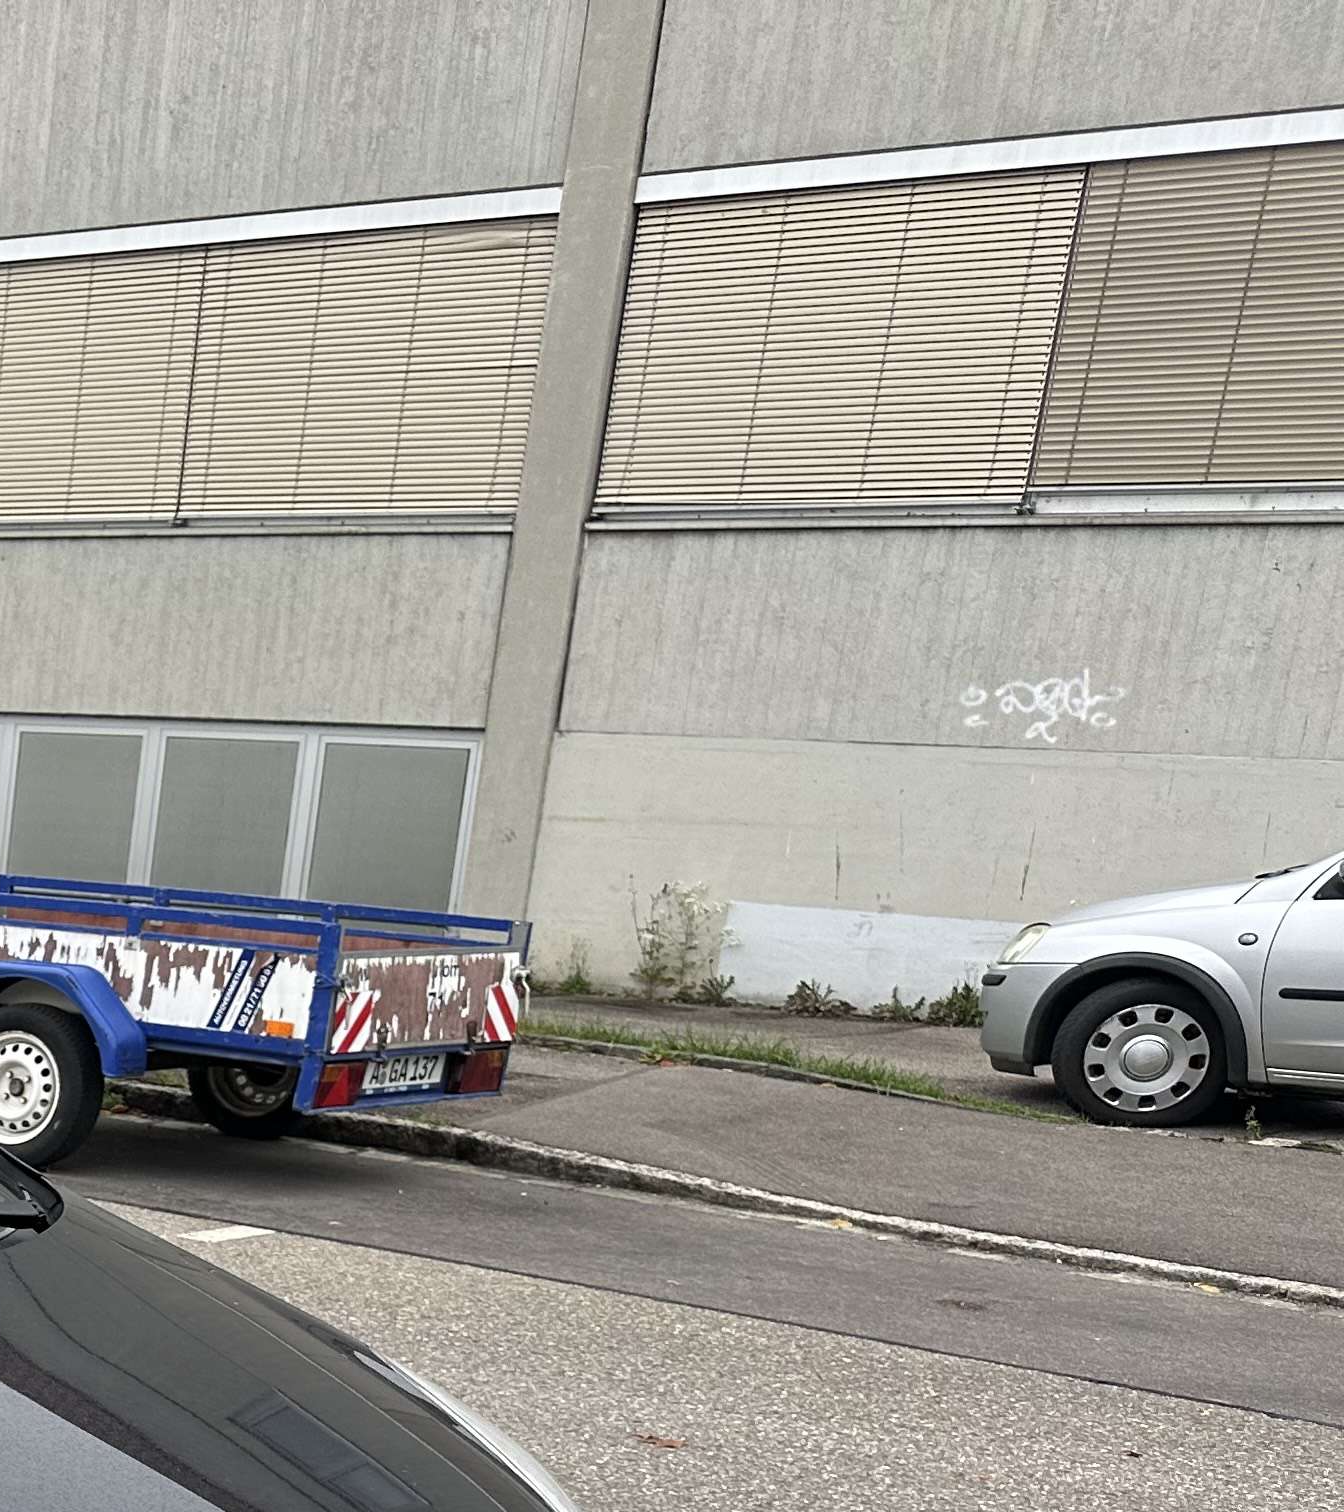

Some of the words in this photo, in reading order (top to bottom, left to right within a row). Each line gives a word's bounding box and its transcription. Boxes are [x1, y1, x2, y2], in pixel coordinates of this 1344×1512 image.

[369, 1062, 381, 1085] A
[389, 1058, 409, 1083] GA
[410, 1055, 439, 1081] 137
